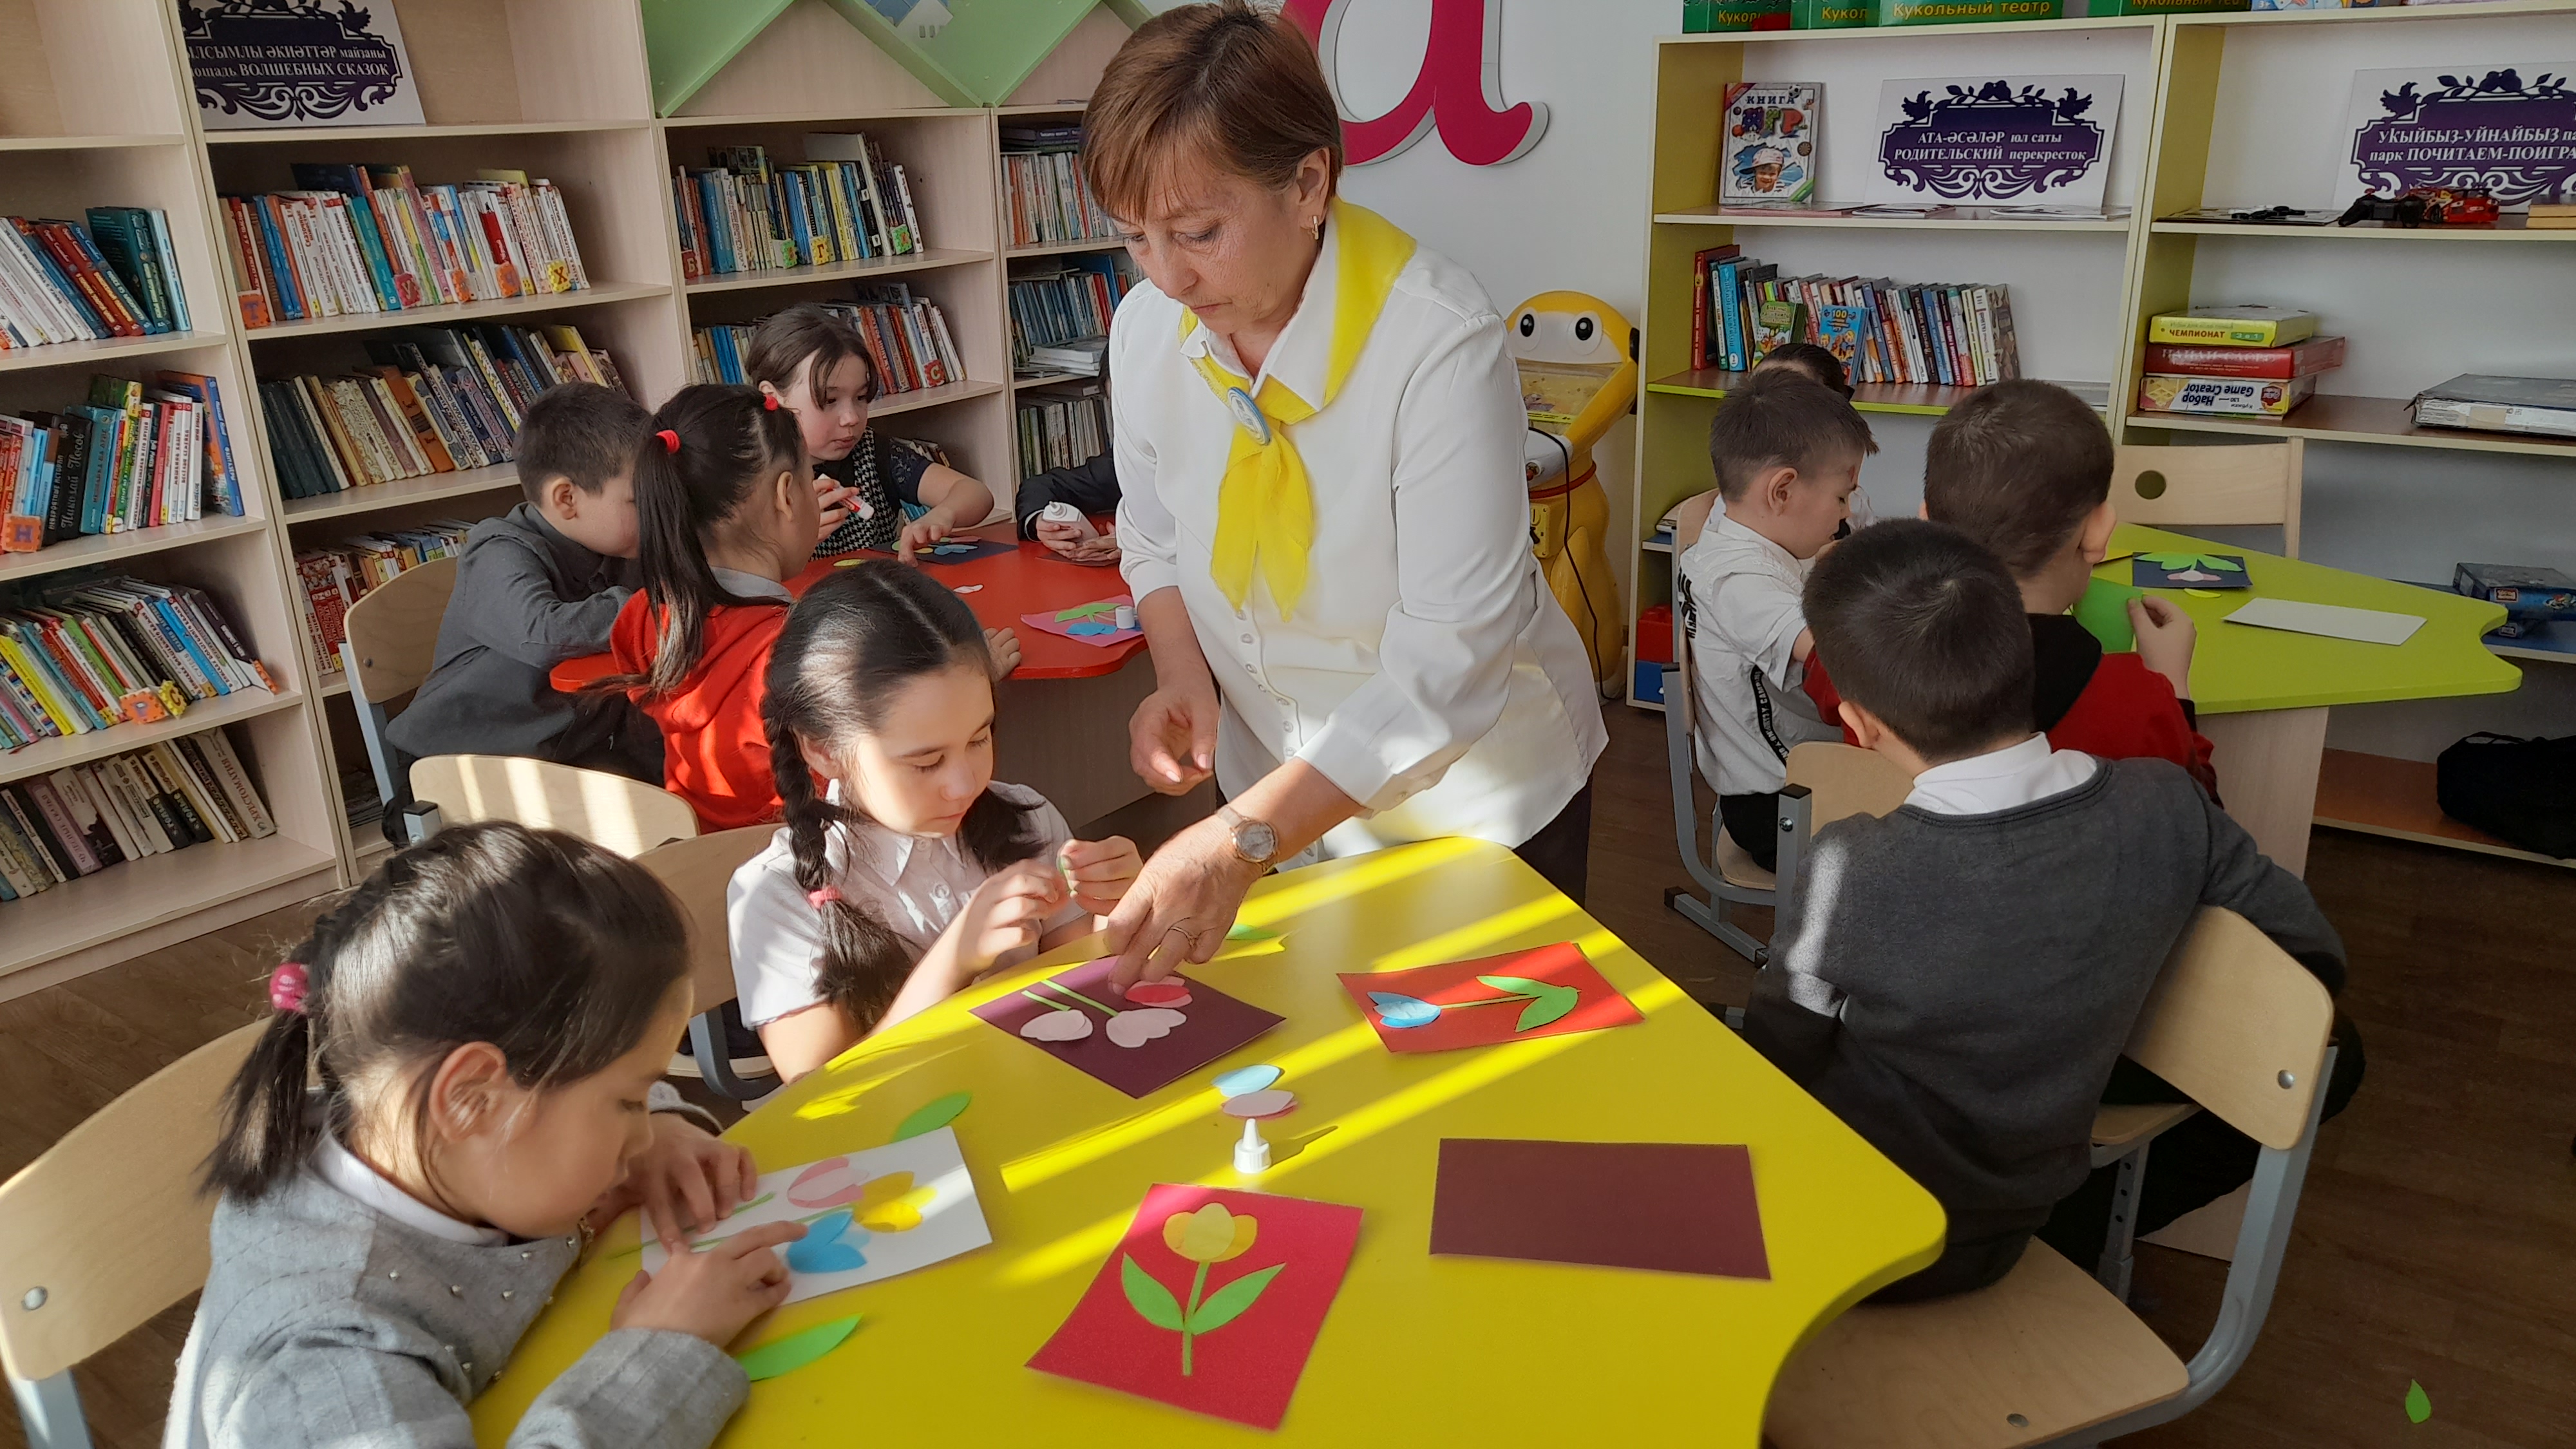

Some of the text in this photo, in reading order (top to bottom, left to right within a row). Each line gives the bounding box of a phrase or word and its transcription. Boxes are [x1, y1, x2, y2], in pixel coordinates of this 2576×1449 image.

[1893, 1, 2050, 18] Кукольный театр
[238, 62, 336, 77] ВОЛШЕБНЫХ
[337, 62, 390, 77] СКАЗОК
[1747, 95, 1795, 104] КНИГА
[1741, 106, 1805, 135] ИГР
[2010, 133, 2028, 144] юл
[2031, 133, 2062, 144] саты
[1894, 146, 2087, 163] РОДИТЕЛЬСКИЙ перекресток
[2370, 150, 2404, 165] парк
[1832, 309, 1848, 318] 100
[2169, 329, 2226, 339] ЧЕМПИОНАТ
[2184, 383, 2222, 395] Creator
[2224, 386, 2255, 397] Game
[2182, 392, 2215, 406] Набор
[67, 431, 85, 469] Носов
[221, 757, 261, 822] ХРЕСТОМАТИЯ
